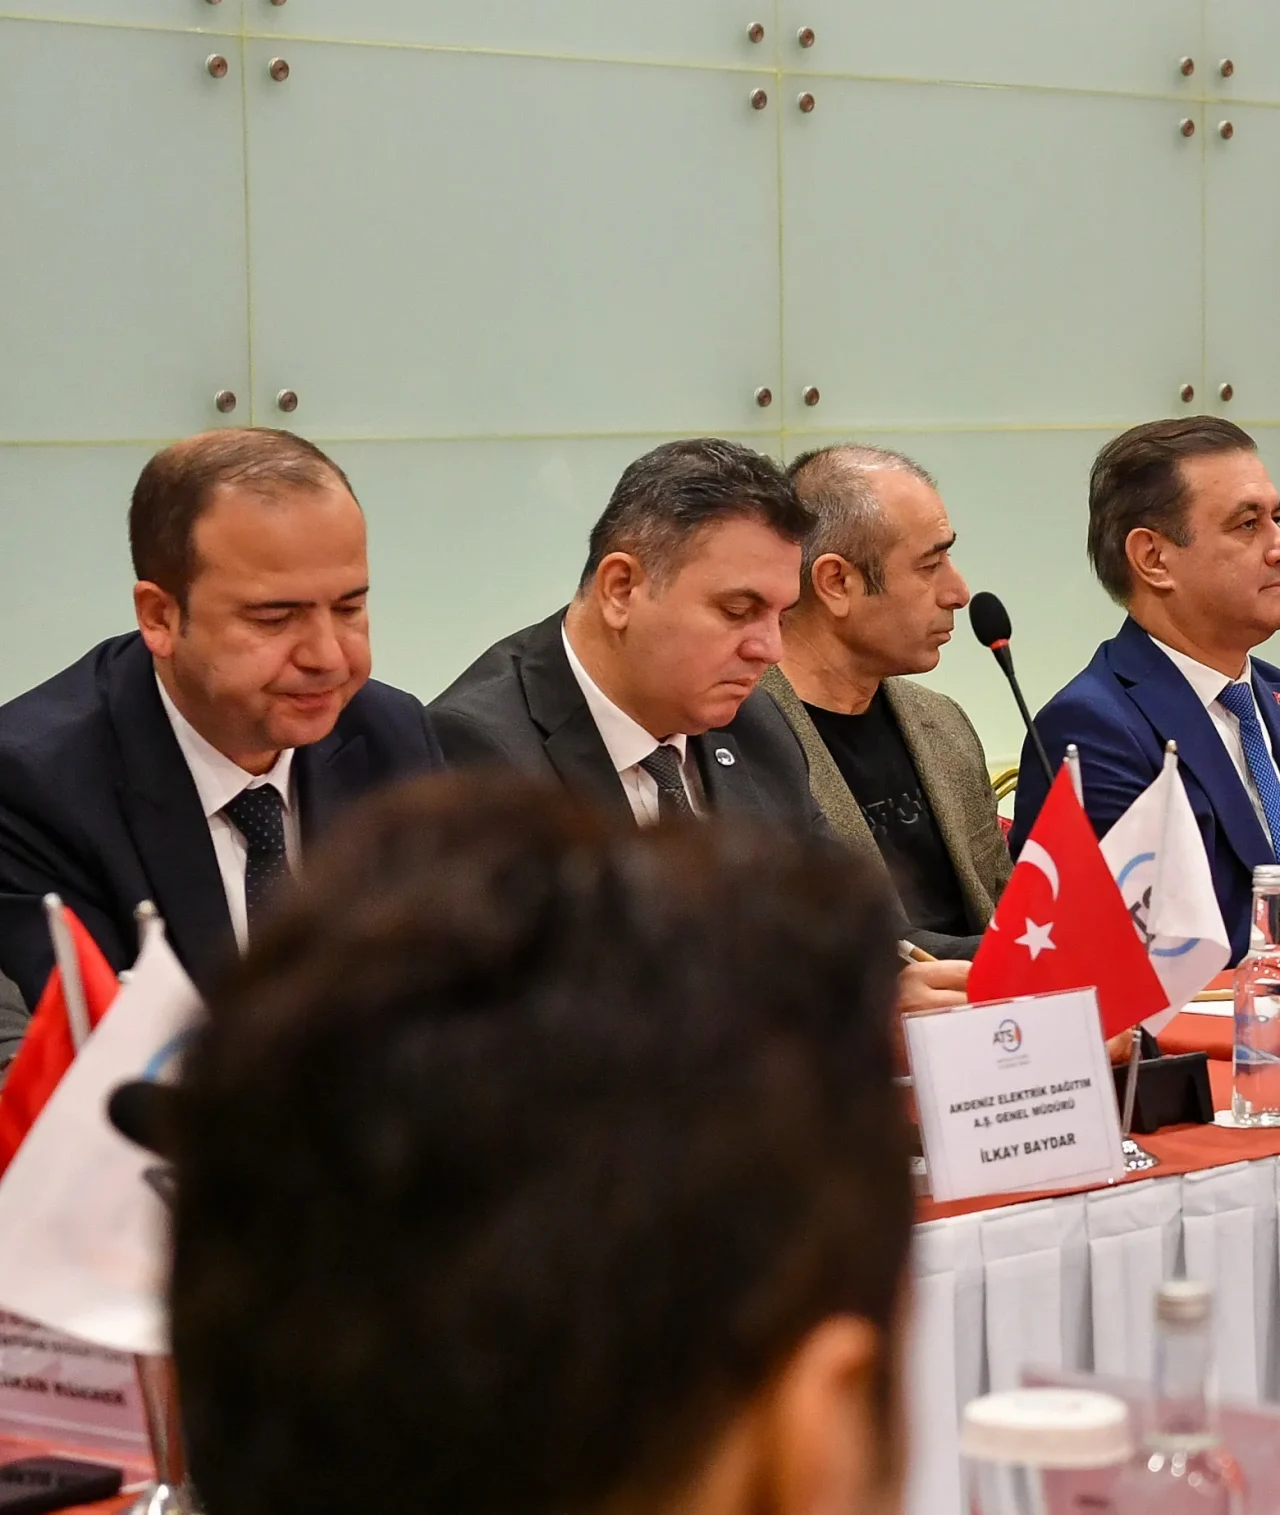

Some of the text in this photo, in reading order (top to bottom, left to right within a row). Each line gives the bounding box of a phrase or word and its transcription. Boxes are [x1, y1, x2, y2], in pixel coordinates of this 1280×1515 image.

[949, 1077, 1092, 1114] AKDENİZ ELEKTRİK DAĞITIM
[995, 1108, 1030, 1125] GENEL
[1032, 1098, 1075, 1117] MÜDÜRÜ
[979, 1132, 1077, 1164] İLKAY BAYDAR
